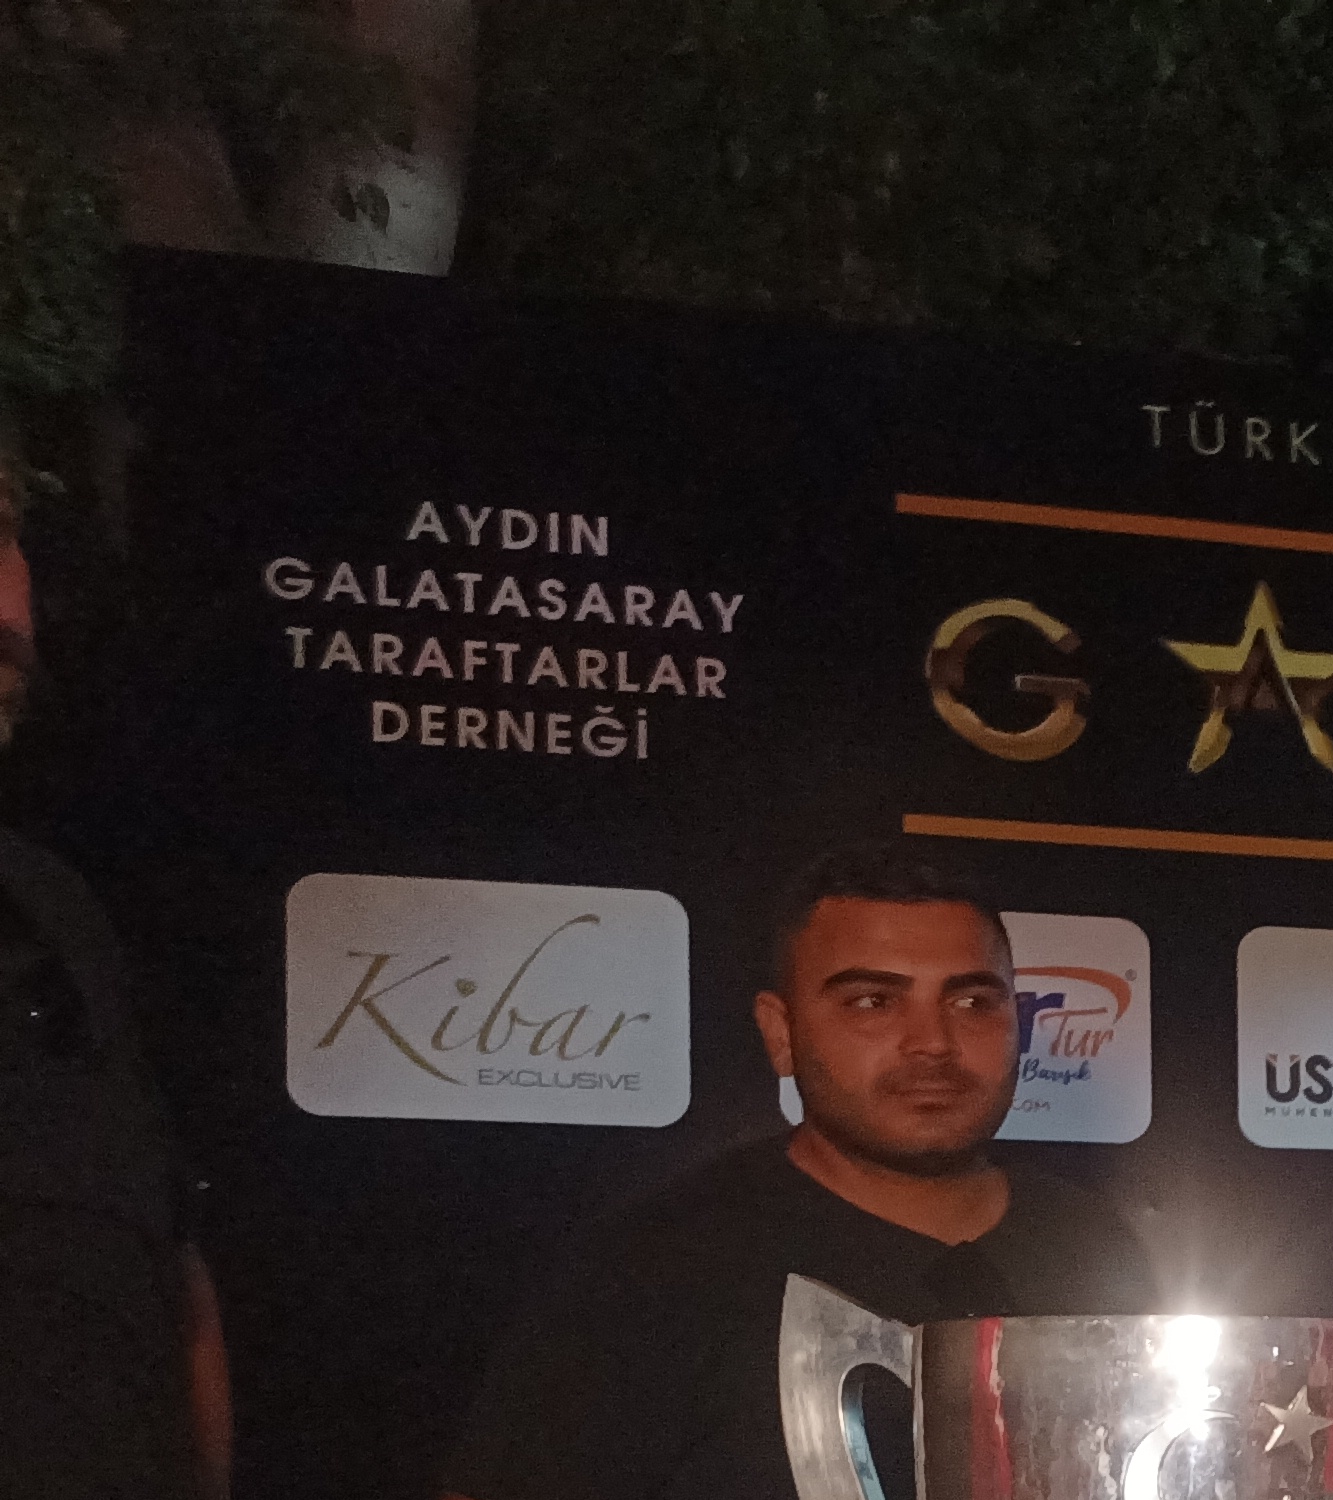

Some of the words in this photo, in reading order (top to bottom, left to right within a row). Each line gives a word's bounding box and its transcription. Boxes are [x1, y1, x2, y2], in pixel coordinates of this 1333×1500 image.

[405, 500, 609, 557] AYDIN
[262, 556, 745, 634] GALATASARAY
[284, 626, 728, 699] TARAFTARLAR
[371, 700, 650, 760] DERNEĞİ
[315, 913, 651, 1087] Kibar
[1038, 1006, 1114, 1058] Tur
[478, 1067, 641, 1092] EXCLUSIVE
